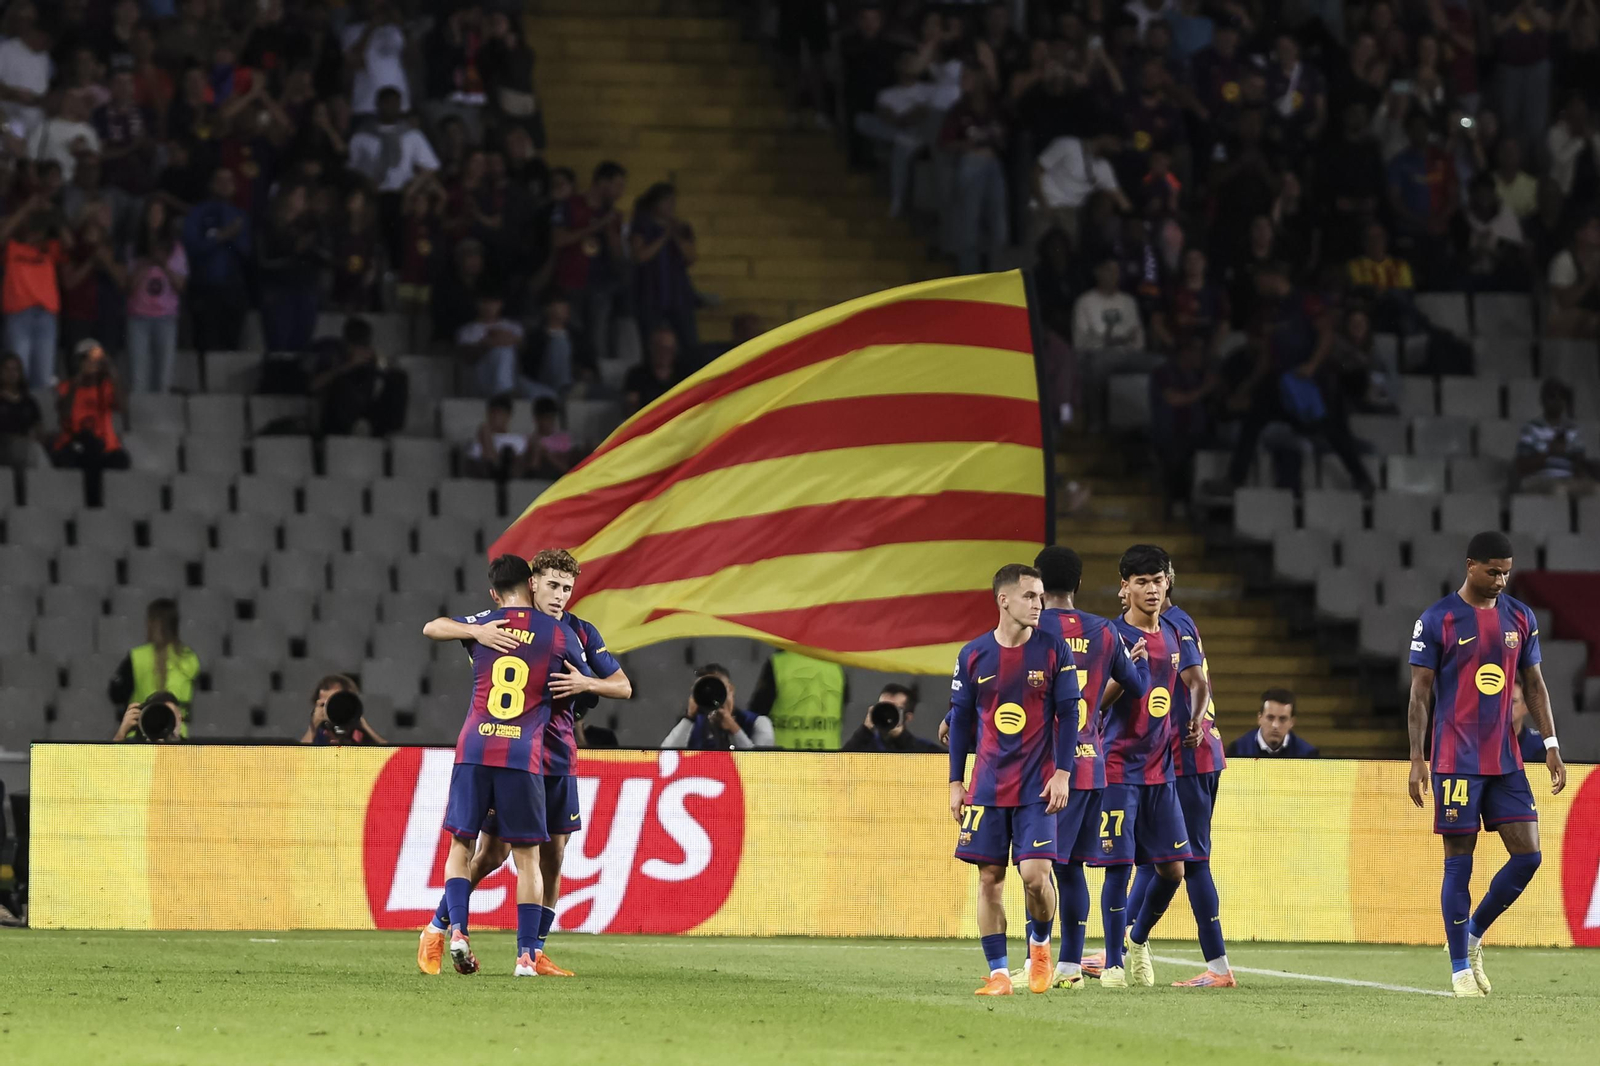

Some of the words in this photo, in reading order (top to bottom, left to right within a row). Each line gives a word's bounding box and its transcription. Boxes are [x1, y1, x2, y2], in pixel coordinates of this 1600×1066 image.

[486, 655, 530, 720] 8
[1442, 778, 1469, 807] 14
[386, 749, 726, 935] Ly's
[1099, 809, 1125, 837] 27
